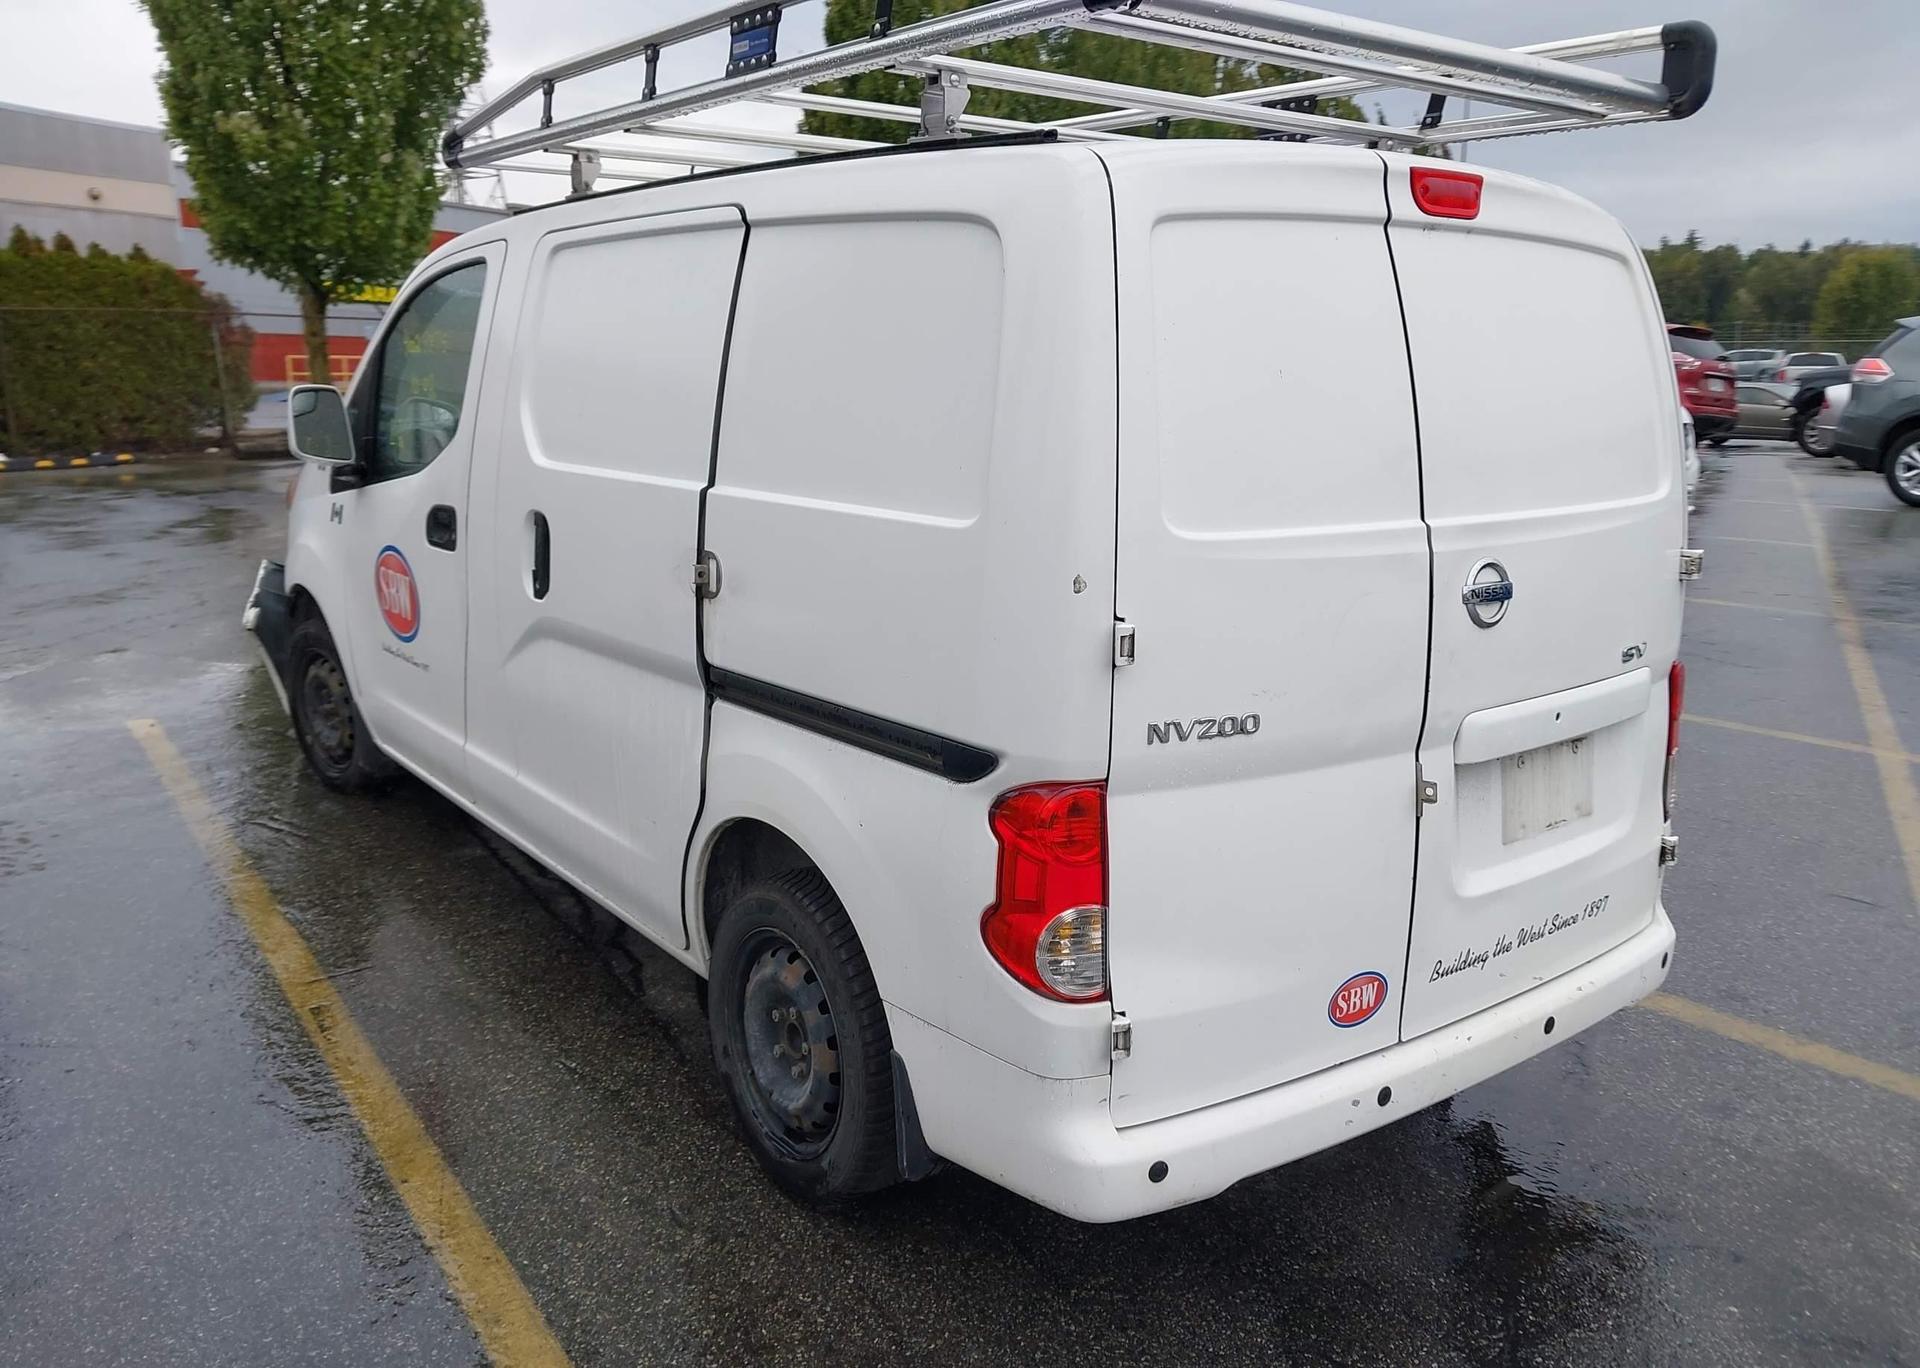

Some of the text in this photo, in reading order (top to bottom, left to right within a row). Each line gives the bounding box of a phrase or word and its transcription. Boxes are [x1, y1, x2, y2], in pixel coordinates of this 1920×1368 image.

[1621, 641, 1648, 664] SV
[1146, 712, 1261, 745] NV200
[1428, 895, 1610, 983] Building the West Since 1897
[1336, 981, 1380, 1018] SBW
